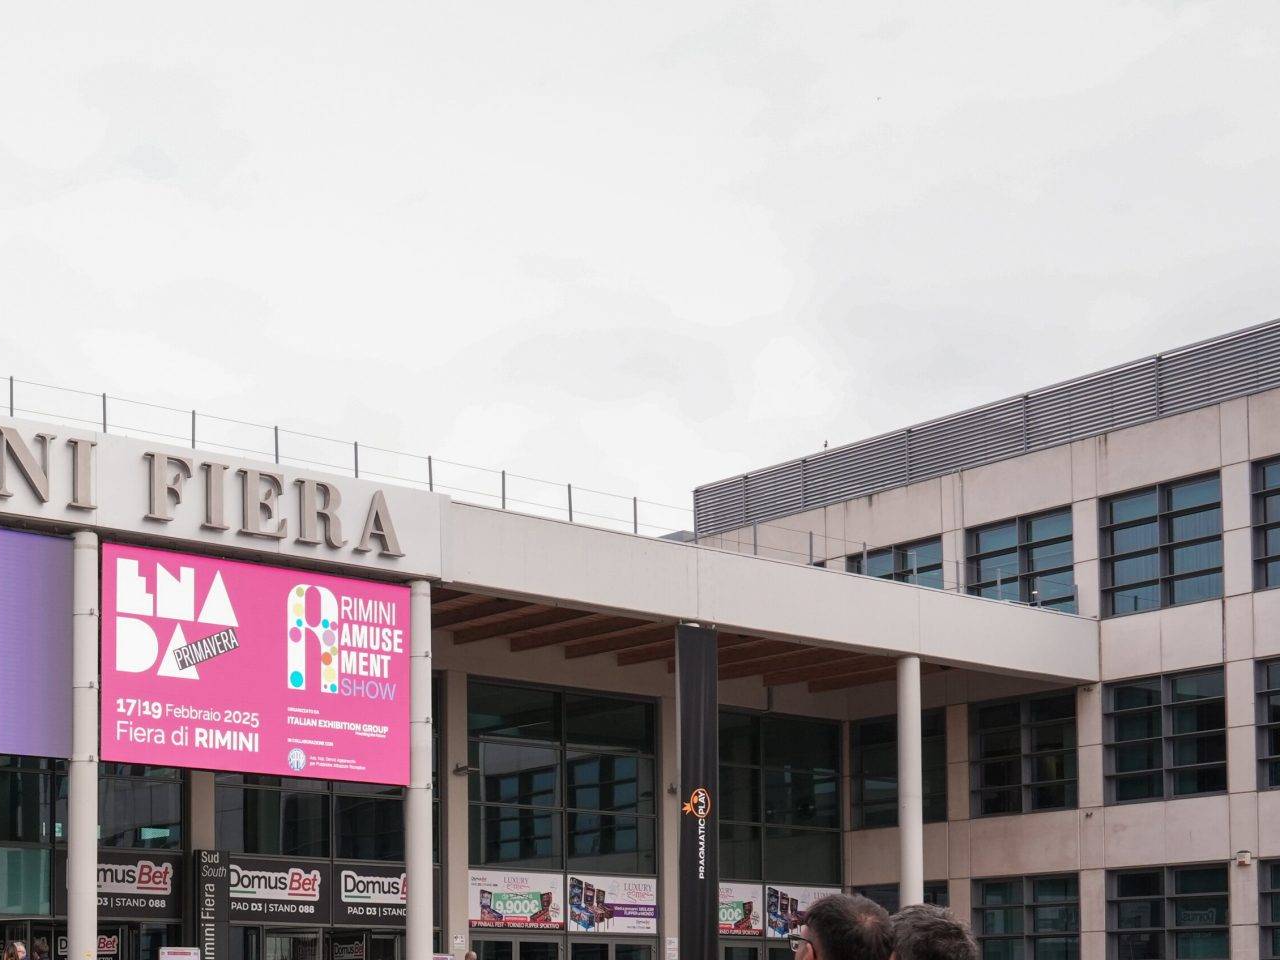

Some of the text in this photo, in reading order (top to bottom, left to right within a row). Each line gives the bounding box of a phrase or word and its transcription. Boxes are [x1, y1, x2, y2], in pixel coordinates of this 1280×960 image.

[143, 451, 406, 558] FIERA
[116, 557, 239, 627] ENA
[341, 595, 396, 626] RIMINI
[174, 628, 239, 670] PRIMAVERA
[341, 623, 403, 653] AMUSE
[341, 650, 391, 678] MENT
[341, 677, 396, 701] SHOW
[166, 704, 221, 721] Febbraio
[224, 710, 260, 728] 2025
[287, 716, 317, 727] ITALIAN
[318, 719, 361, 731] EXHIBITION
[362, 724, 389, 735] GROUP
[116, 720, 259, 752] Fiera di RIMINI
[698, 791, 706, 879] PRAGMATIC PLAY
[201, 851, 219, 863] Sud
[97, 864, 170, 885] musBet
[201, 865, 227, 877] South
[229, 868, 317, 891] DomusBet
[503, 876, 529, 884] LUXURY
[344, 874, 407, 895] Domus
[624, 883, 652, 891] LUXURY
[115, 897, 147, 907] STAND
[148, 899, 166, 908] 088
[201, 883, 215, 919] Fiera
[231, 902, 315, 913] PAD D3 STAND 088
[347, 906, 365, 915] PAD
[366, 907, 377, 915] D3
[495, 900, 539, 914] 9.900€
[720, 908, 741, 920] 00€
